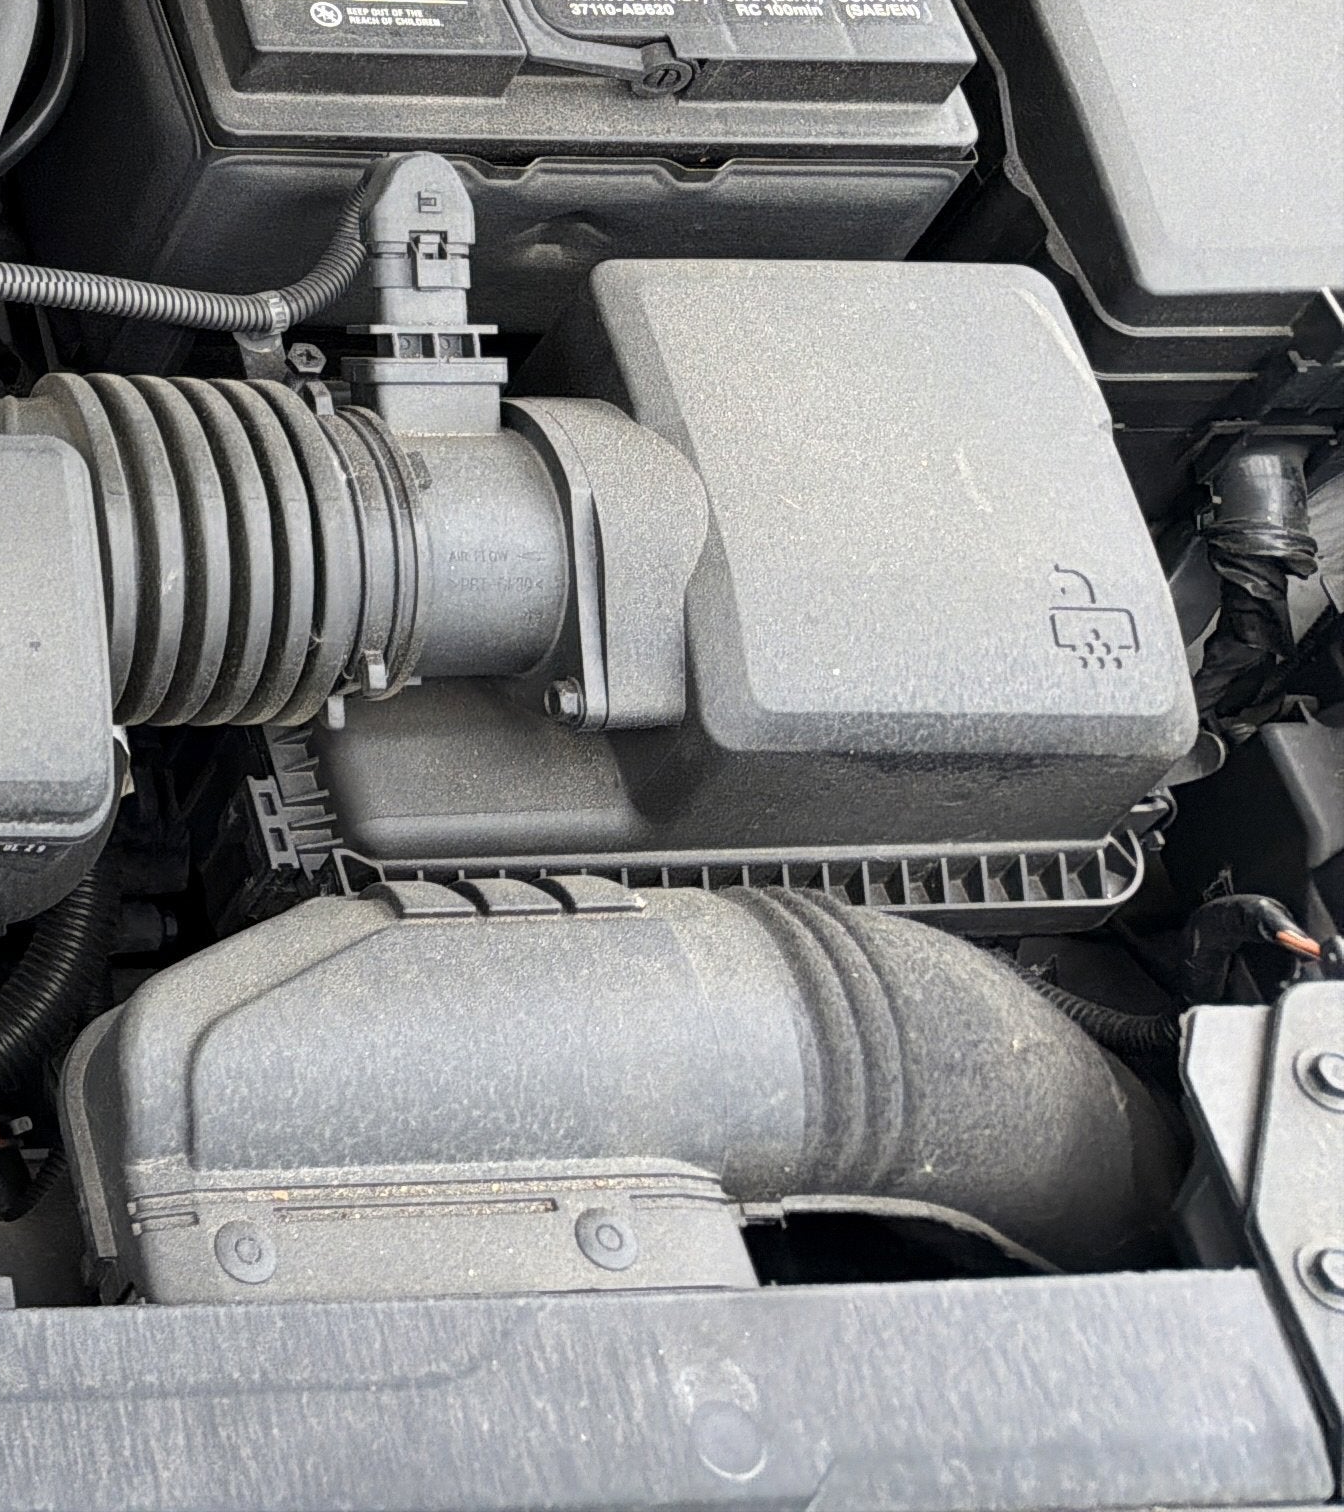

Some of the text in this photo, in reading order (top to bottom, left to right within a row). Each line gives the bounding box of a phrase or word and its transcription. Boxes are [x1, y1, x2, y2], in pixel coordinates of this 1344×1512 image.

[347, 7, 423, 18] KEEP OUT OF THE
[735, 3, 824, 16] RC 100min
[845, 3, 921, 19] (SAE/EN)
[349, 16, 380, 25] REACH
[382, 17, 393, 25] OF
